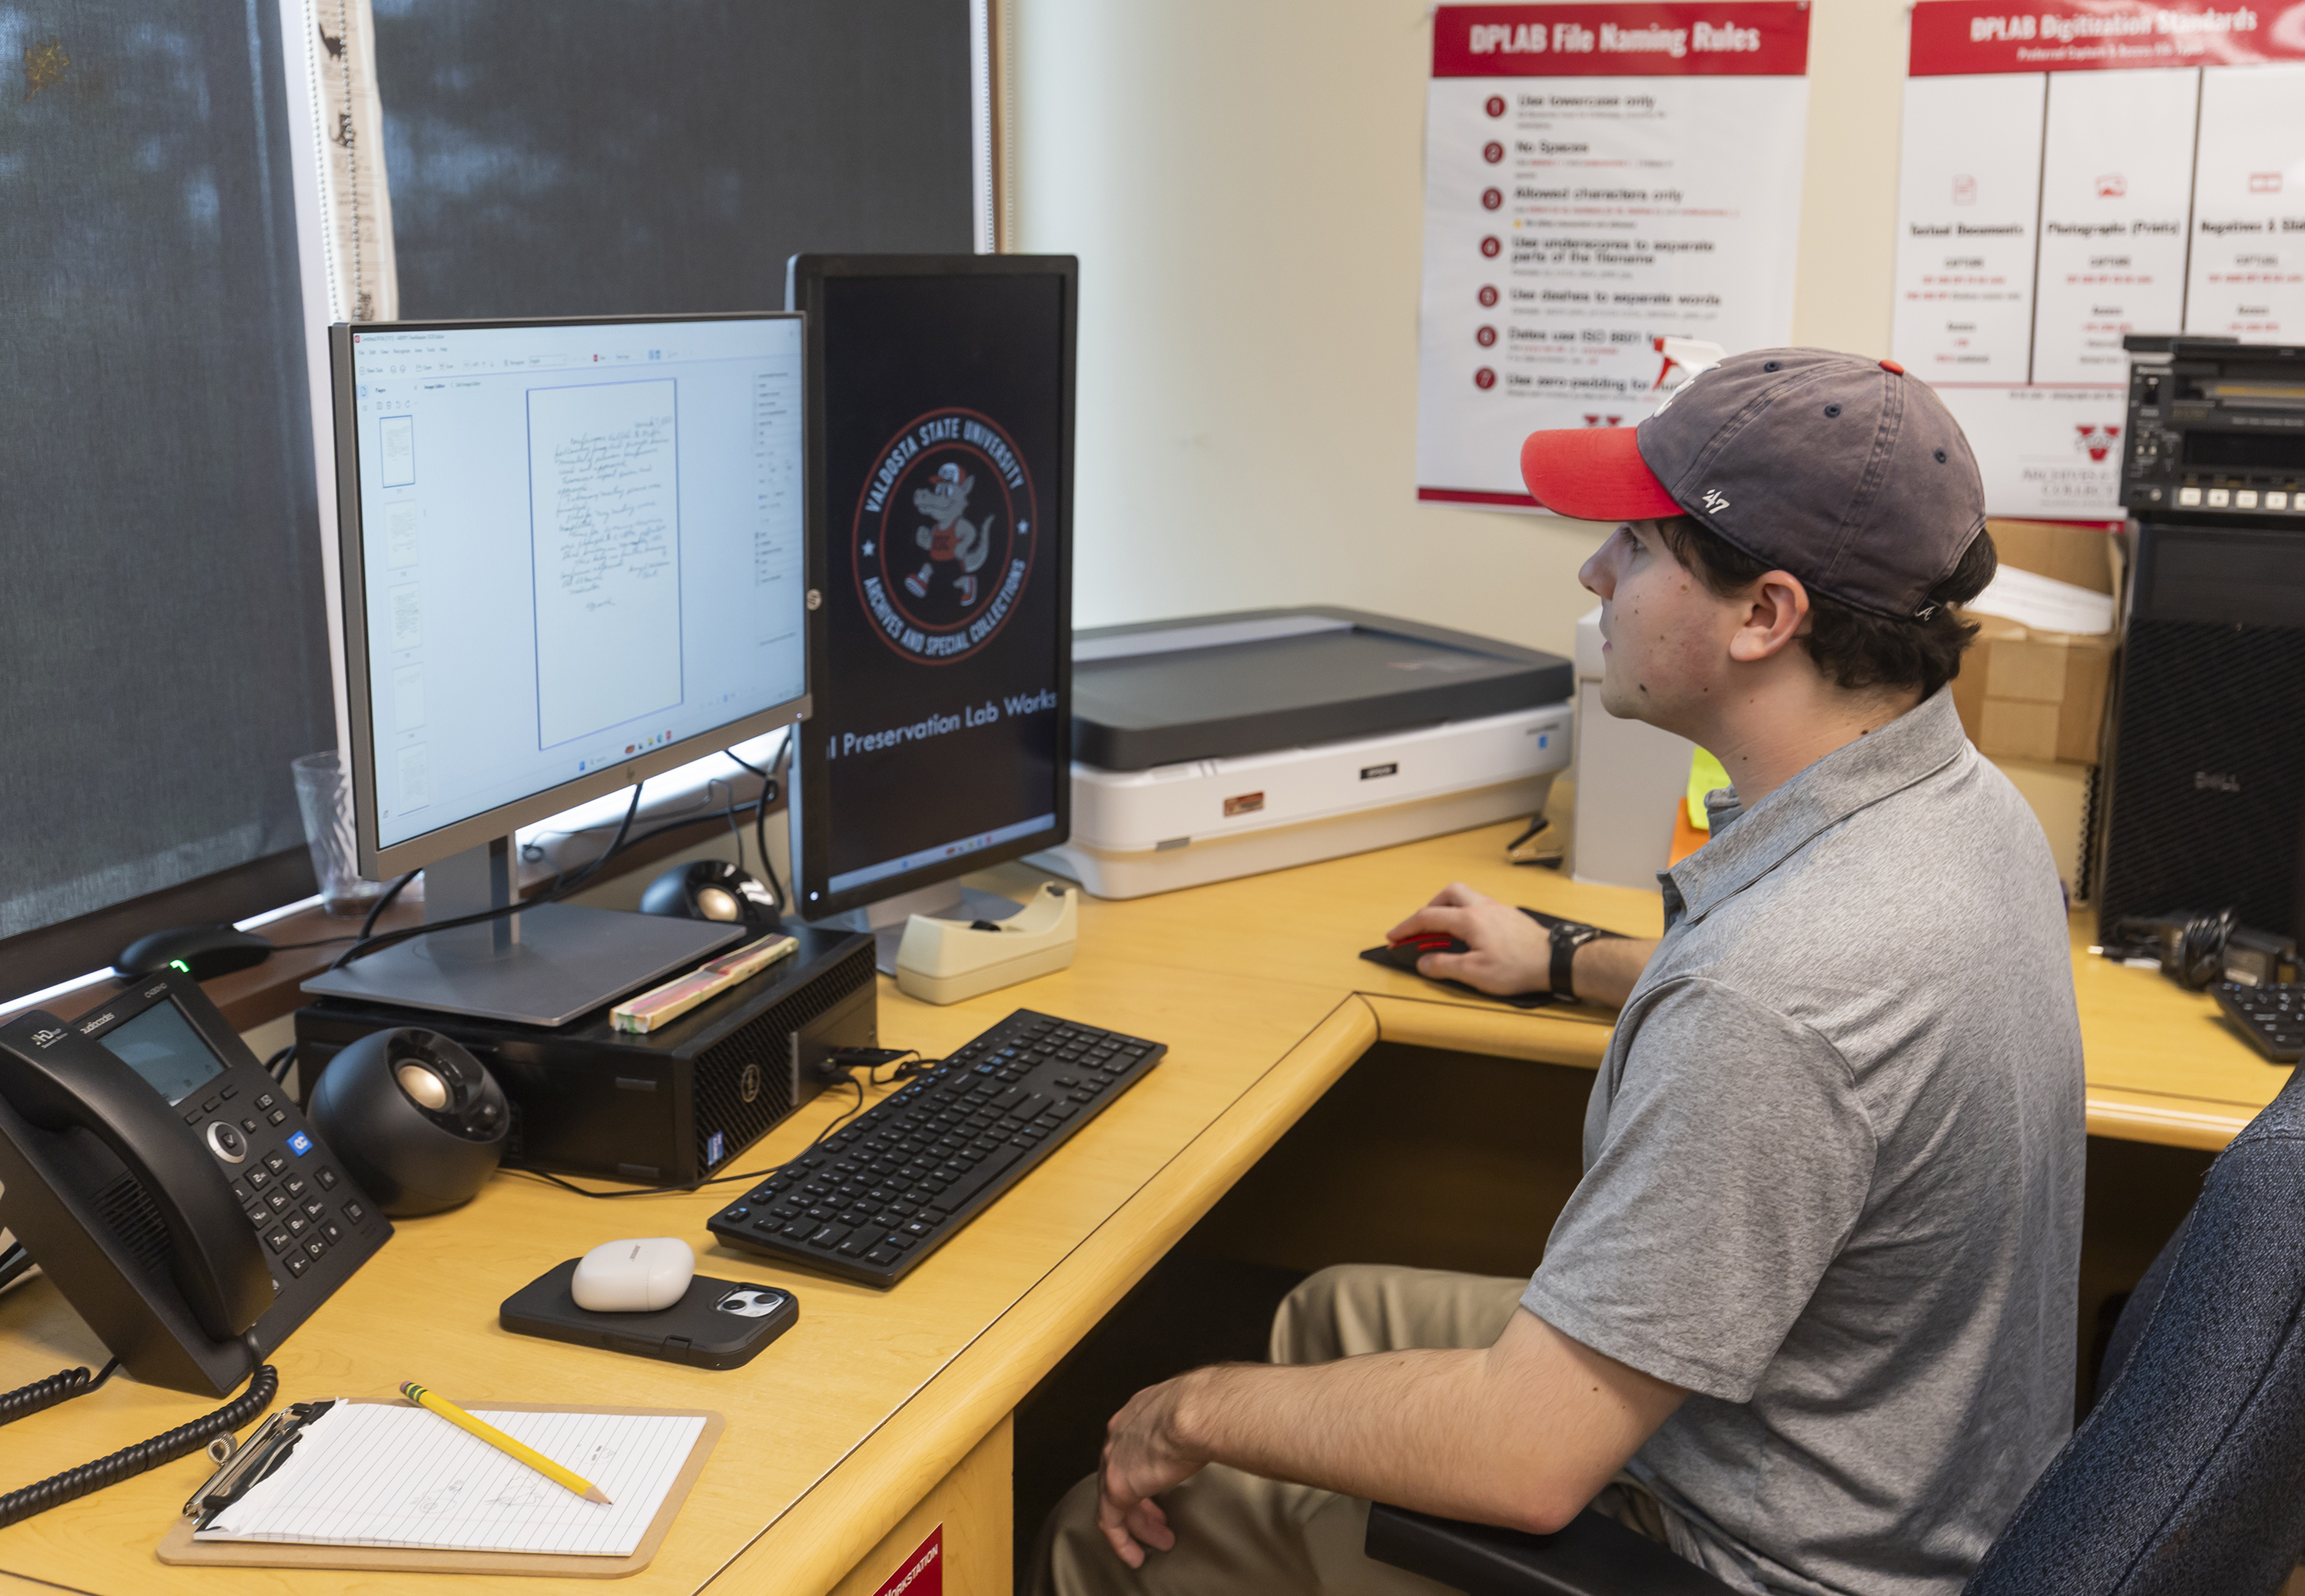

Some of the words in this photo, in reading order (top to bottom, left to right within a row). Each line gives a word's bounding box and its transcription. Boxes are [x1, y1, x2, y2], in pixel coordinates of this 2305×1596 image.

[1970, 16, 2038, 41] DPLAB
[2040, 13, 2153, 42] Digitization
[2156, 7, 2258, 33] Standards
[1469, 25, 1548, 54] DPLAB
[1552, 25, 1594, 54] File
[1599, 24, 1689, 58] Naming
[1692, 22, 1761, 53] Rules
[1518, 95, 1543, 106] Use
[1550, 95, 1619, 108] lowercase
[1626, 95, 1657, 111] only
[1516, 142, 1535, 152] No
[1540, 141, 1590, 155] Spaces
[1515, 187, 1570, 200] Allowed
[1574, 187, 1647, 201] characters
[1653, 188, 1685, 204] only
[1513, 238, 1537, 247] Use
[1545, 237, 1630, 251] underscores
[1636, 241, 1647, 251] to
[1653, 241, 1715, 254] separate
[1511, 253, 1544, 266] parts
[1552, 253, 1566, 264] of
[1571, 253, 1590, 264] the
[1597, 252, 1655, 265] filename
[1509, 289, 1535, 300] Use
[1541, 289, 1590, 301] dashes
[1596, 291, 1607, 302] to
[1614, 293, 1673, 306] separate
[1678, 294, 1722, 307] words
[1509, 327, 1547, 340] Dates
[1553, 330, 1576, 341] use
[1507, 373, 1531, 386] Use
[864, 435, 920, 514] VALDOSTA
[918, 417, 960, 447] STATE
[963, 419, 1024, 490] UNIVERSITY
[863, 575, 906, 639] ARCHIVES
[900, 626, 925, 653] AND
[924, 631, 970, 658] SPECIAL
[968, 558, 1027, 644] COLLECTIONS
[843, 713, 961, 757] Preservation
[964, 700, 1000, 729] Lab
